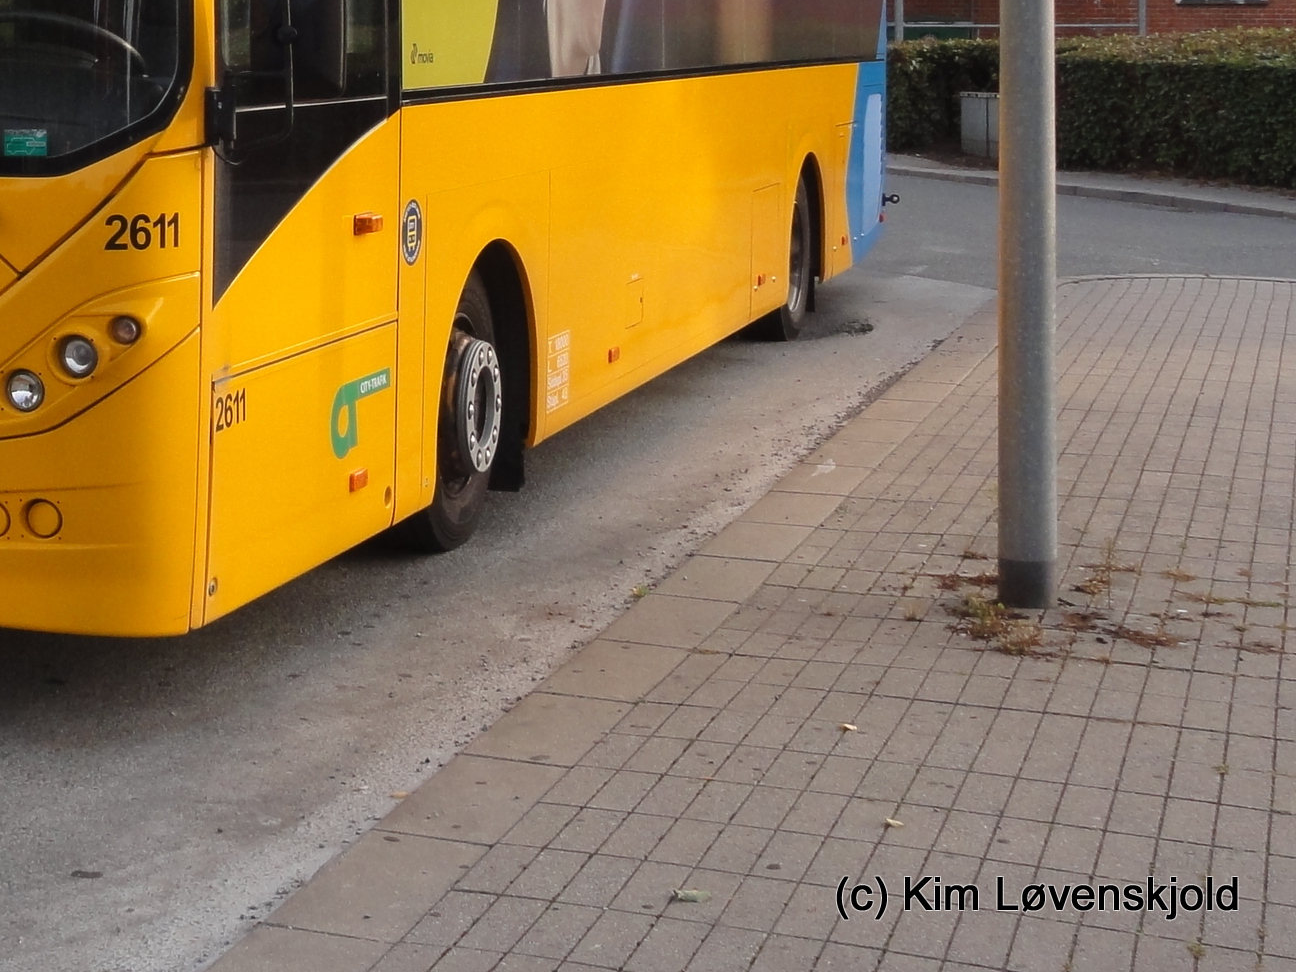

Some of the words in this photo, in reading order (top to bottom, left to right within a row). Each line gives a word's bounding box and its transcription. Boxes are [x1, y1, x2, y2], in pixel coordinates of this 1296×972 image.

[418, 49, 434, 64] movia
[104, 212, 180, 251] 2611
[215, 387, 247, 433] 2611
